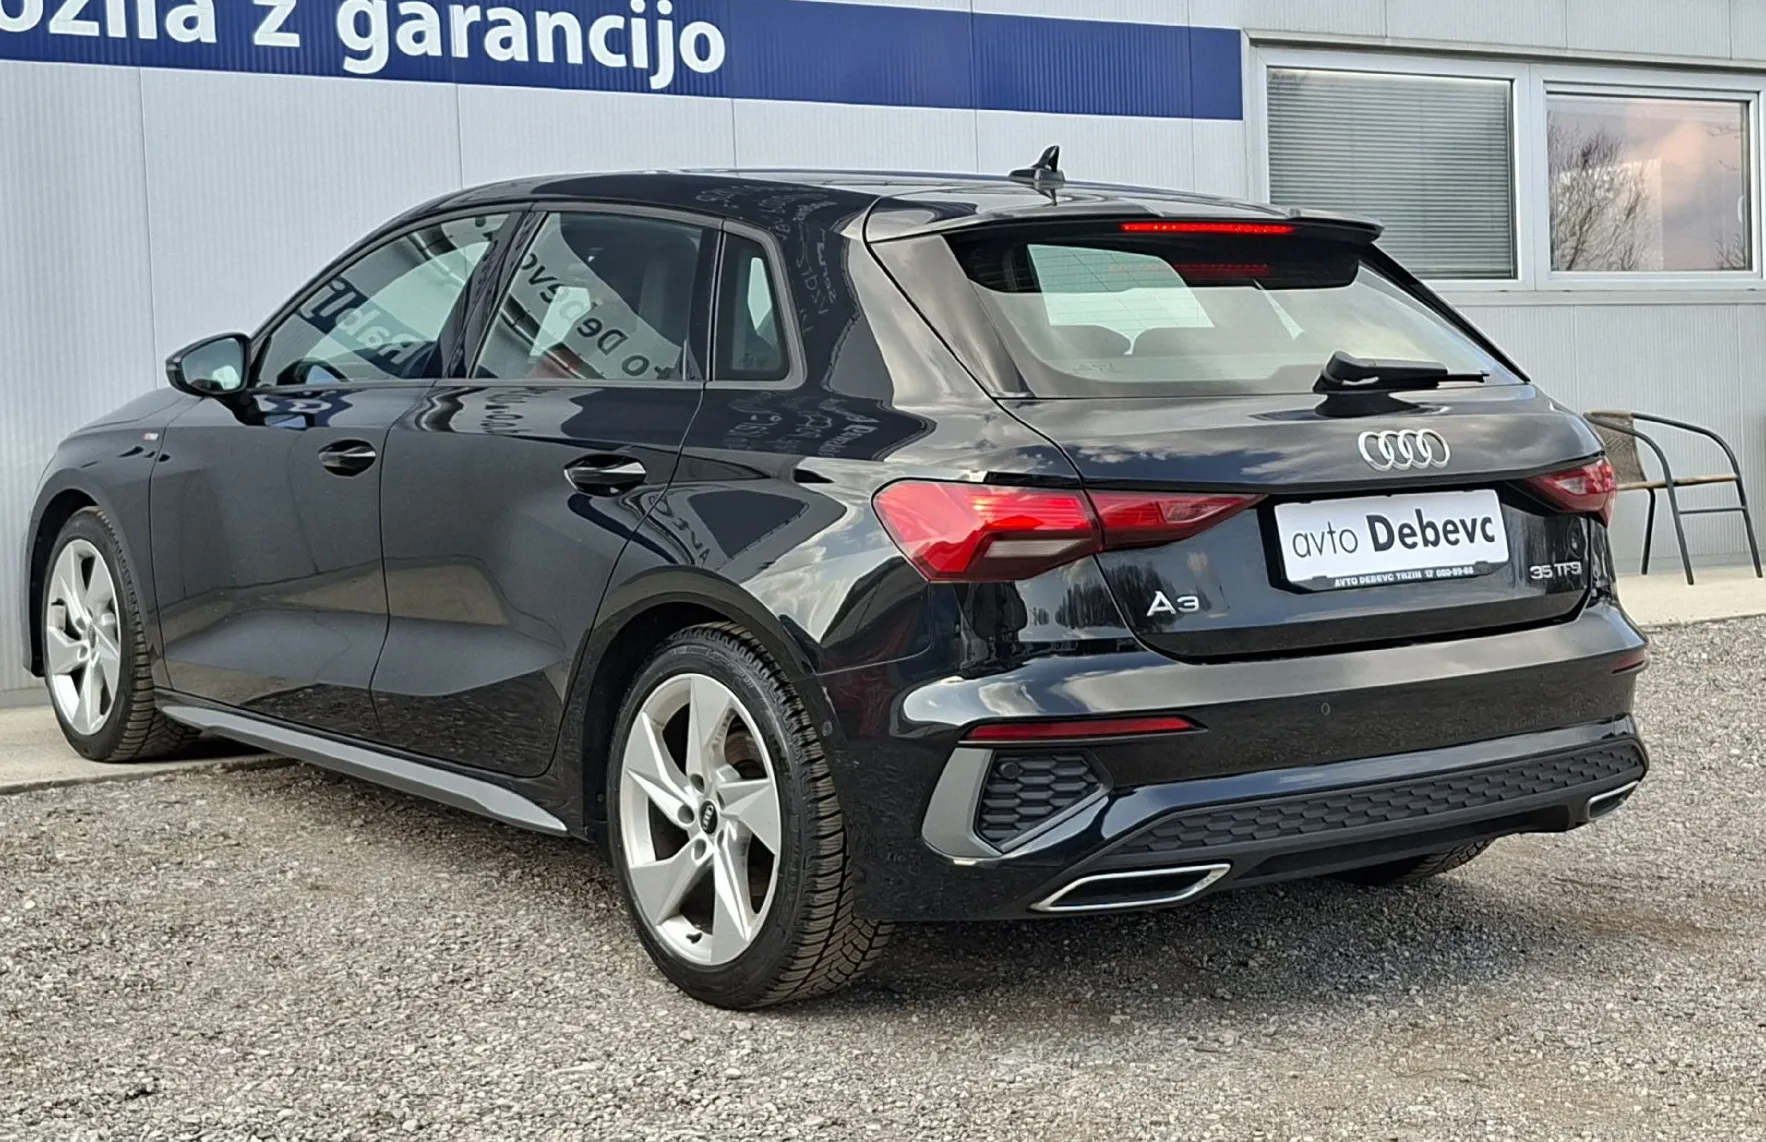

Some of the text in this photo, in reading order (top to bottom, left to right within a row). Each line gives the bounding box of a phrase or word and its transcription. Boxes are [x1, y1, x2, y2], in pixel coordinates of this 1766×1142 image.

[253, 0, 301, 48] z
[336, 0, 726, 90] garancijo
[1292, 508, 1496, 558] avto Debevc
[1334, 577, 1359, 588] AVTO
[1359, 573, 1395, 585] DEBEVC
[1529, 560, 1582, 579] 35 TFSI
[1146, 590, 1200, 617] A3
